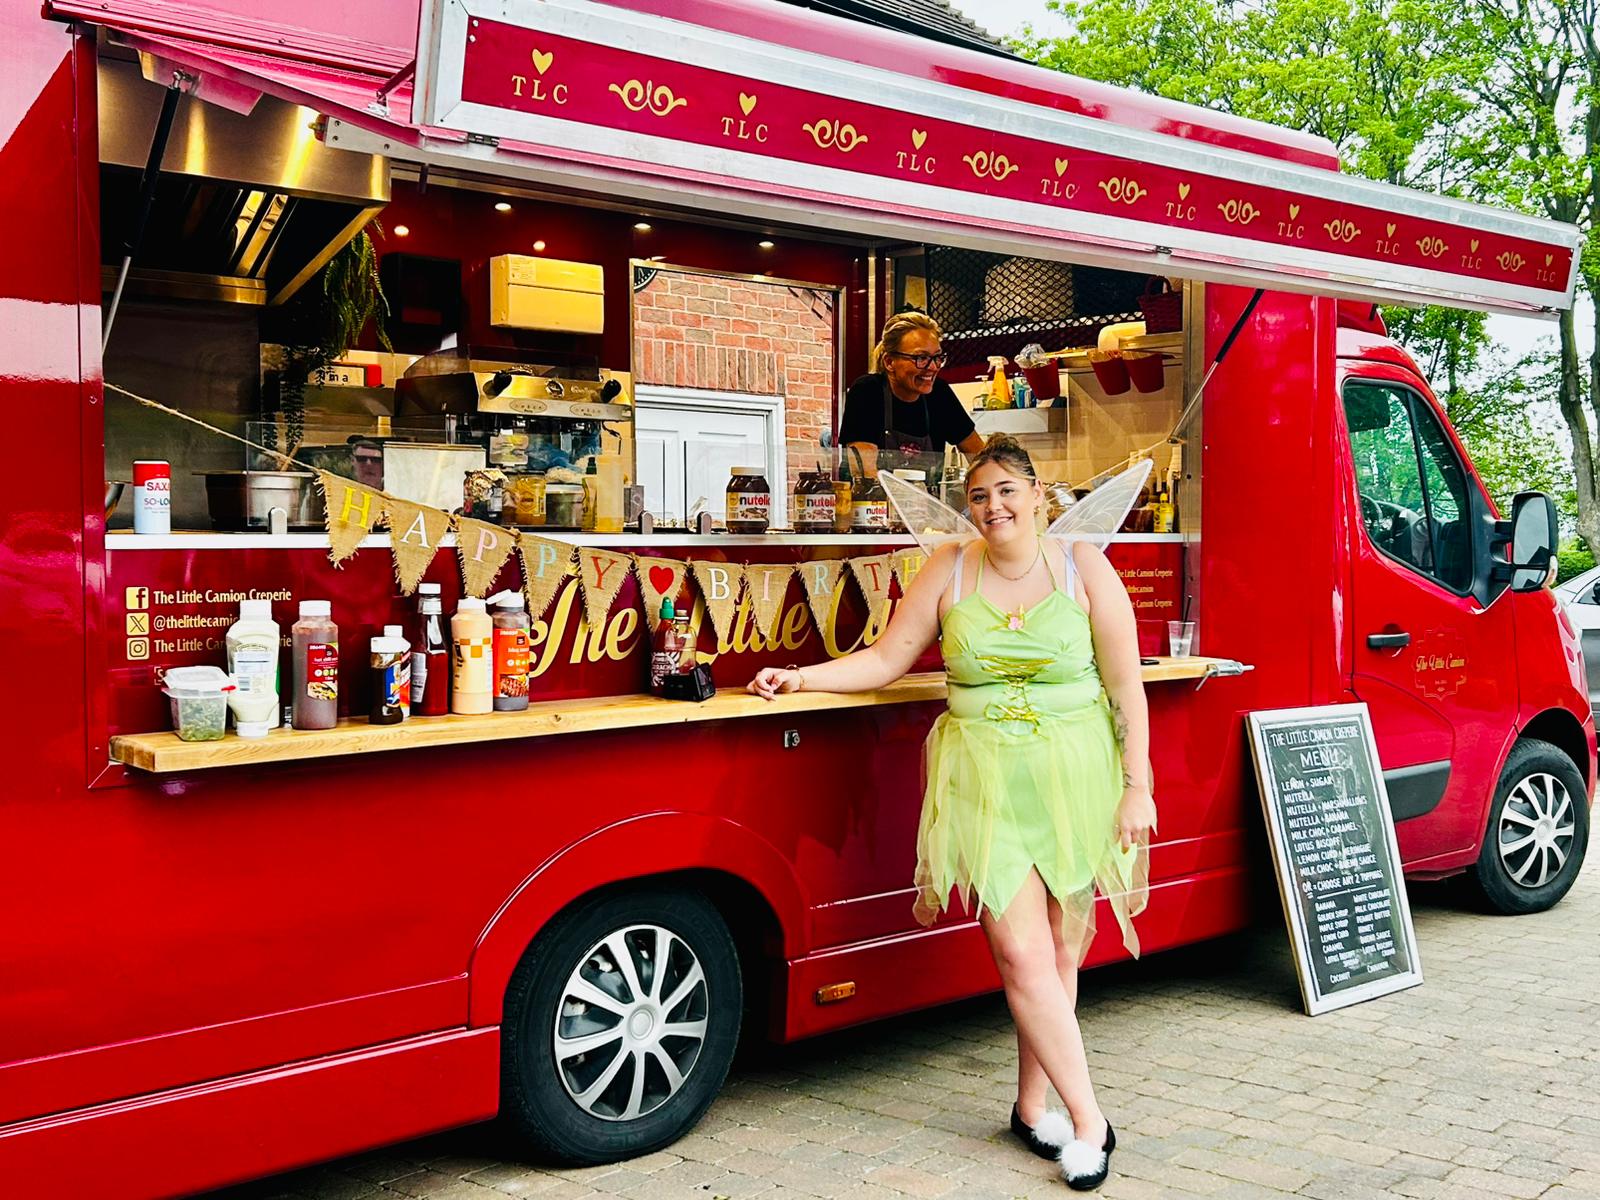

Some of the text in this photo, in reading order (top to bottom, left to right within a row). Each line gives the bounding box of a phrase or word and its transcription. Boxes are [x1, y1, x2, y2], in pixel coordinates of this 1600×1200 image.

[512, 75, 568, 104] TLC
[721, 117, 768, 142] TLC
[897, 151, 936, 174] TLC
[1041, 179, 1075, 199] TLC
[1166, 202, 1196, 222] TLC
[1278, 223, 1304, 240] TLC
[1376, 239, 1400, 256] TLC
[1461, 254, 1482, 270] TLC
[1537, 268, 1556, 283] TLC
[144, 498, 171, 506] SO-LO
[154, 588, 292, 604] The Little Camion Creperie
[154, 639, 174, 652] The
[177, 638, 203, 652] Little
[1270, 733, 1286, 747] THE
[1286, 730, 1309, 745] LITTLE
[1300, 747, 1339, 768] MENU
[1281, 778, 1305, 791] LEMON
[1310, 776, 1333, 787] SUGAR
[1283, 791, 1315, 804] NUTELLA
[1286, 804, 1318, 816] NUTELLA
[1289, 816, 1320, 828] NUTELLA
[1291, 830, 1307, 840] MILK
[1309, 828, 1325, 838] CHOC
[1330, 822, 1358, 833] CARAMEL
[1294, 837, 1340, 852] LOTUS BISCOFF
[1297, 853, 1320, 864] LEMON
[1300, 866, 1315, 877] MILK
[1317, 863, 1334, 873] CHOC
[1360, 855, 1376, 865] SAUCE
[1317, 879, 1341, 891] CHOOSE
[1343, 876, 1354, 886] ANY
[1355, 874, 1360, 883] 2
